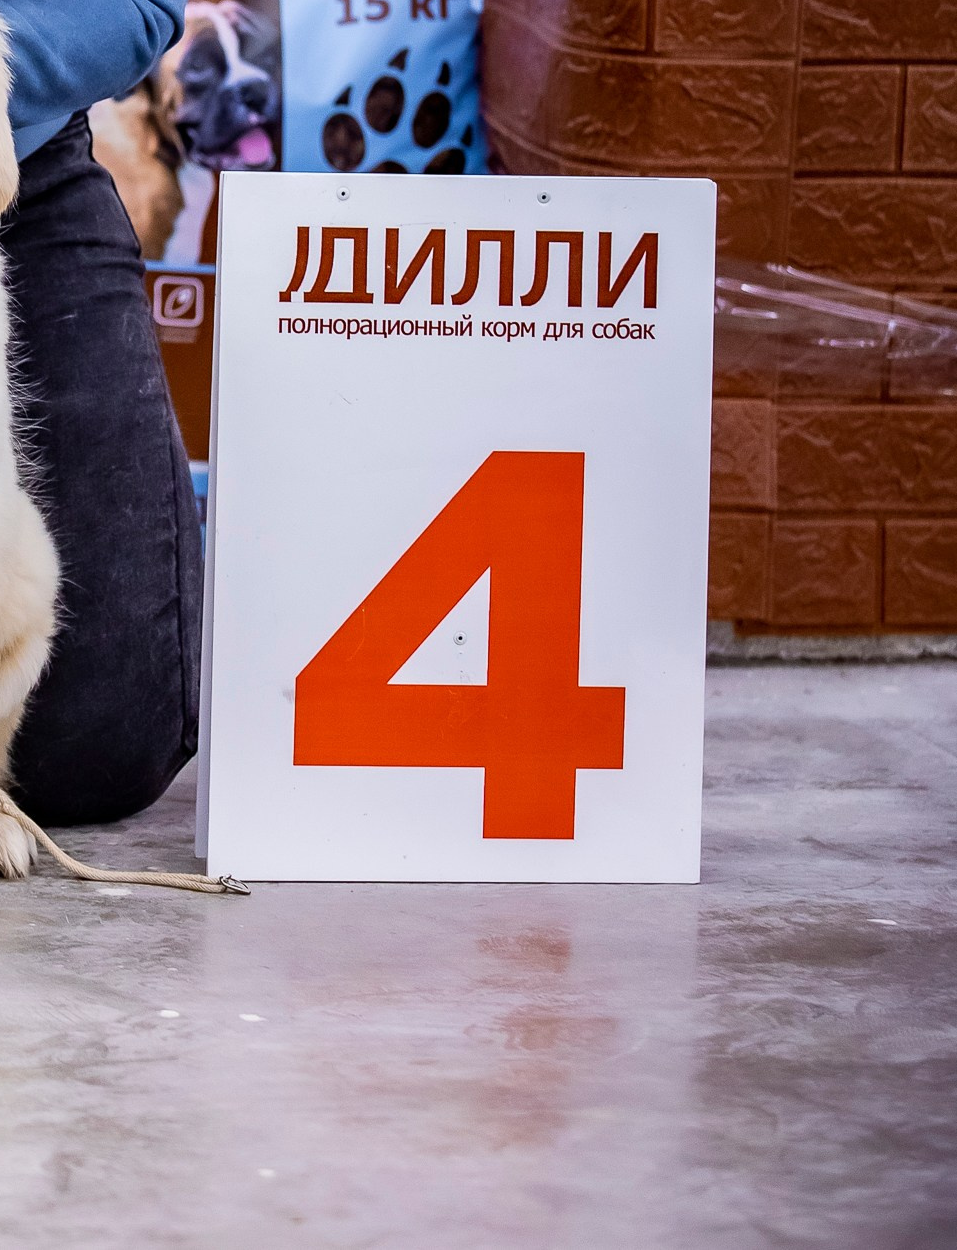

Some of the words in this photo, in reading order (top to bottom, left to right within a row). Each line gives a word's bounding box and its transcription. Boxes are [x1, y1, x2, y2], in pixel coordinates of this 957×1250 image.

[278, 226, 660, 310] ДИЛЛИ
[278, 314, 474, 340] полнорационный
[481, 319, 536, 342] корм
[542, 319, 585, 342] для
[591, 317, 657, 340] собак
[293, 450, 626, 840] 4
